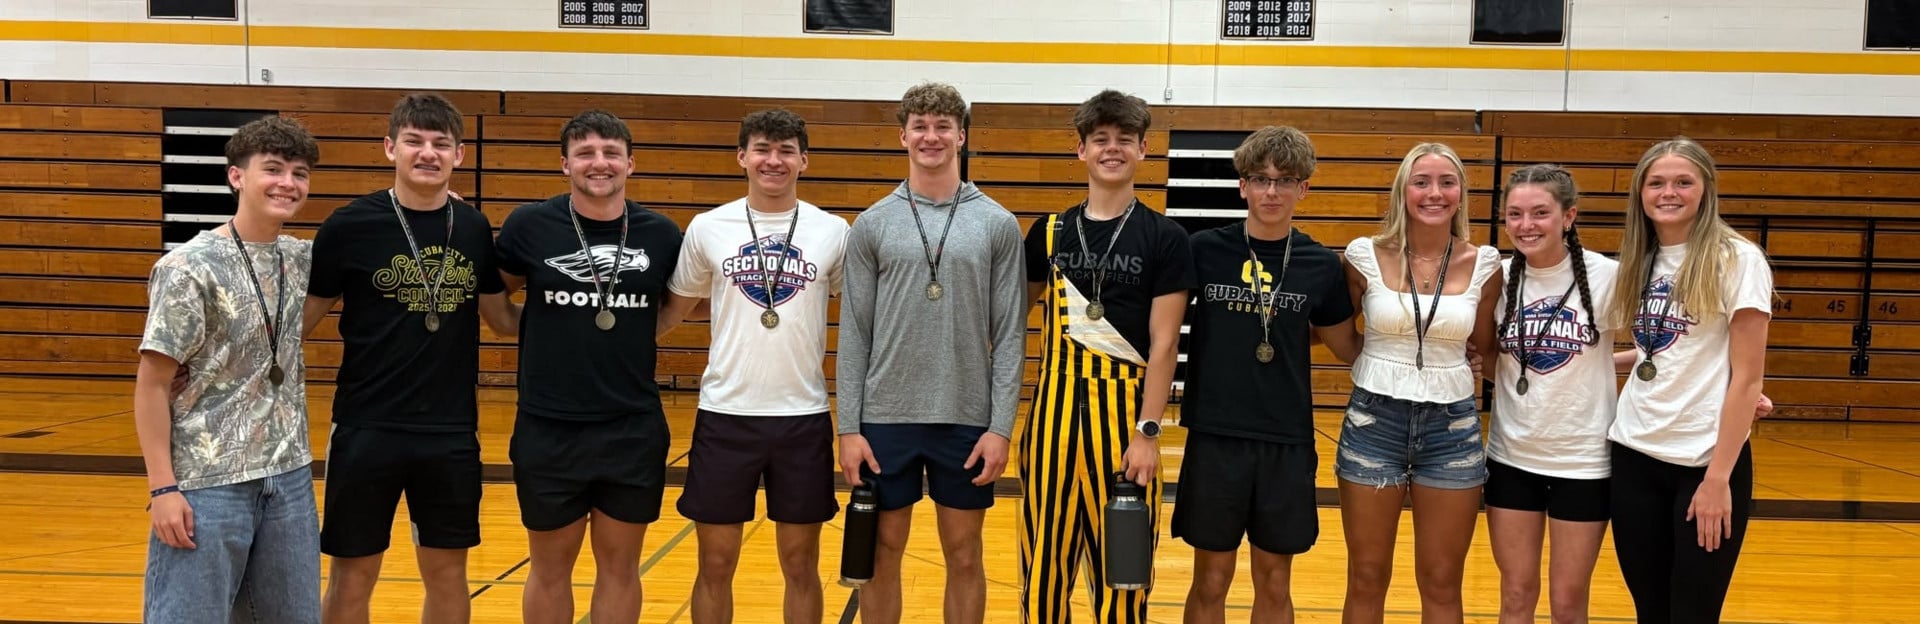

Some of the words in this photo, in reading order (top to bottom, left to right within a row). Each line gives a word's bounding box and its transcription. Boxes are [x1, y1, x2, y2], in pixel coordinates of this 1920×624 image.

[564, 2, 586, 11] 2005
[592, 2, 615, 12] 2006
[621, 3, 644, 13] 2007
[1228, 1, 1251, 11] 2009
[1257, 1, 1281, 11] 2012
[1286, 2, 1310, 11] 2013
[564, 14, 586, 24] 2008
[592, 14, 615, 24] 2009
[621, 15, 644, 25] 2010
[1227, 13, 1251, 23] 2014
[1257, 13, 1280, 23] 2015
[1287, 13, 1310, 23] 2017
[1227, 25, 1251, 36] 2018
[1257, 26, 1280, 36] 2019
[1286, 25, 1309, 35] 2021
[420, 245, 443, 258] CUBA
[446, 247, 466, 262] CITY
[1055, 252, 1144, 275] CUBANS
[372, 255, 477, 292] Student
[735, 273, 763, 282] TRACK
[1106, 271, 1140, 285] FIELD
[544, 290, 649, 308] FOOTBALL
[1205, 284, 1256, 303] CUBA
[1260, 291, 1307, 312] CTY
[1772, 300, 1792, 313] 44
[1826, 300, 1846, 314] 45
[1879, 302, 1898, 315] 46
[1506, 320, 1591, 344] ECTIONALS
[1663, 320, 1684, 331] IELD
[1507, 340, 1537, 348] TRCK
[1551, 340, 1580, 350] FIELD
